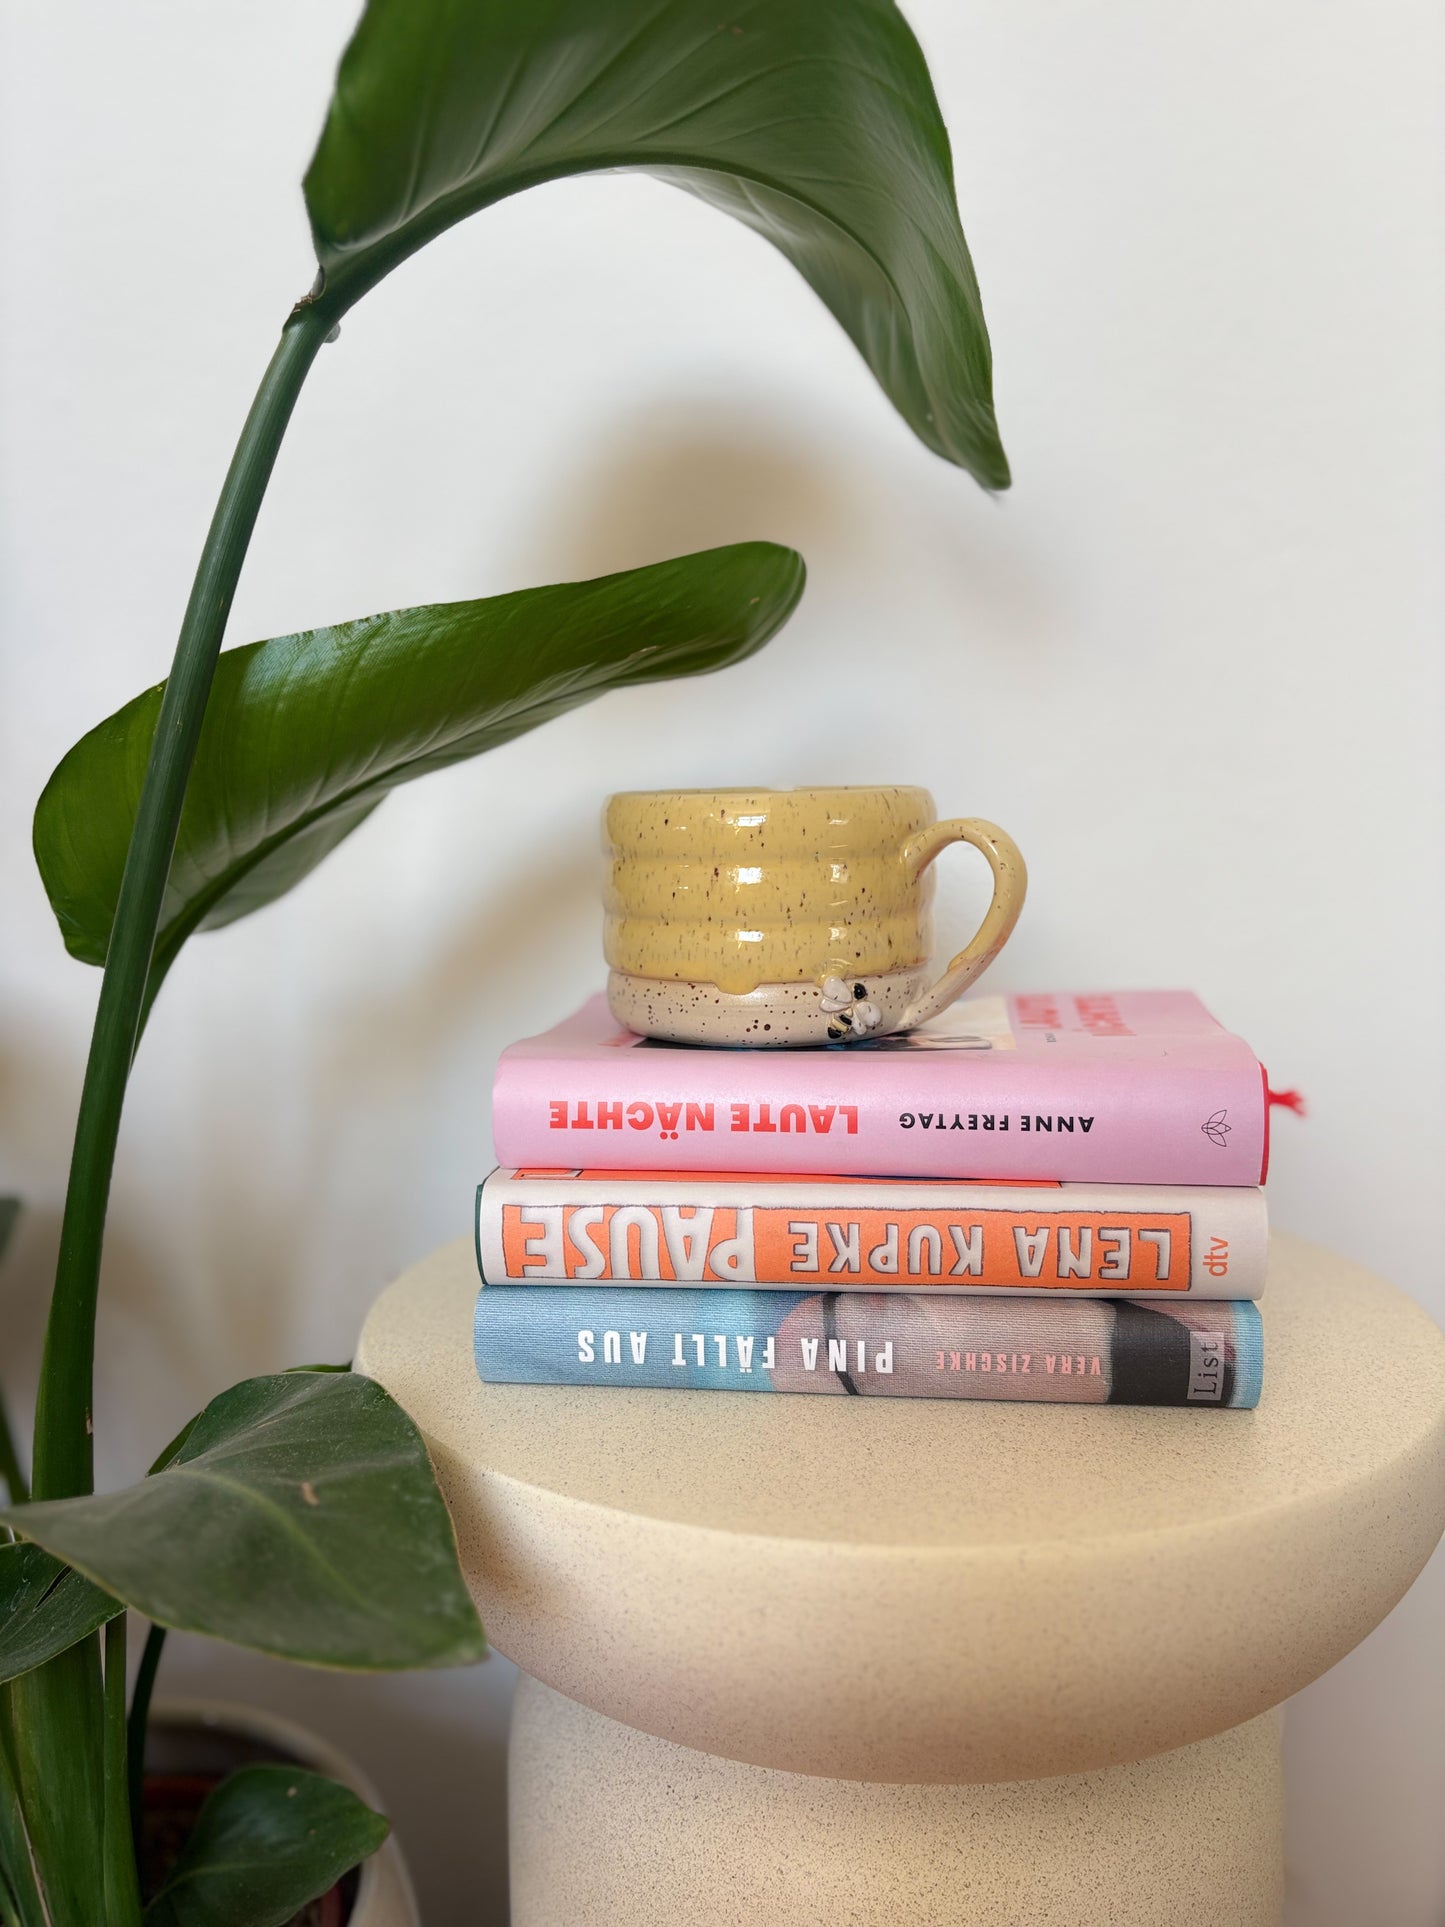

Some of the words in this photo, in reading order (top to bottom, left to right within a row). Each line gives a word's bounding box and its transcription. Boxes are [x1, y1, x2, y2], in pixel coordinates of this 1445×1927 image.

[549, 1101, 715, 1139] NÄCHTE
[731, 1104, 858, 1134] LAUTE
[900, 1112, 1010, 1132] FREYTAG
[1021, 1116, 1094, 1132] ANNE
[521, 1205, 755, 1280] PAUSE
[788, 1221, 984, 1275] KUPKE
[1012, 1226, 1171, 1280] LENA
[1203, 1236, 1229, 1277] dtv
[577, 1330, 647, 1364] AUS
[672, 1333, 775, 1373] FÄLLT
[801, 1338, 893, 1373] PINA
[936, 1350, 1030, 1372] ZISCHKE
[1045, 1354, 1100, 1374] VERA
[1193, 1341, 1218, 1396] List
